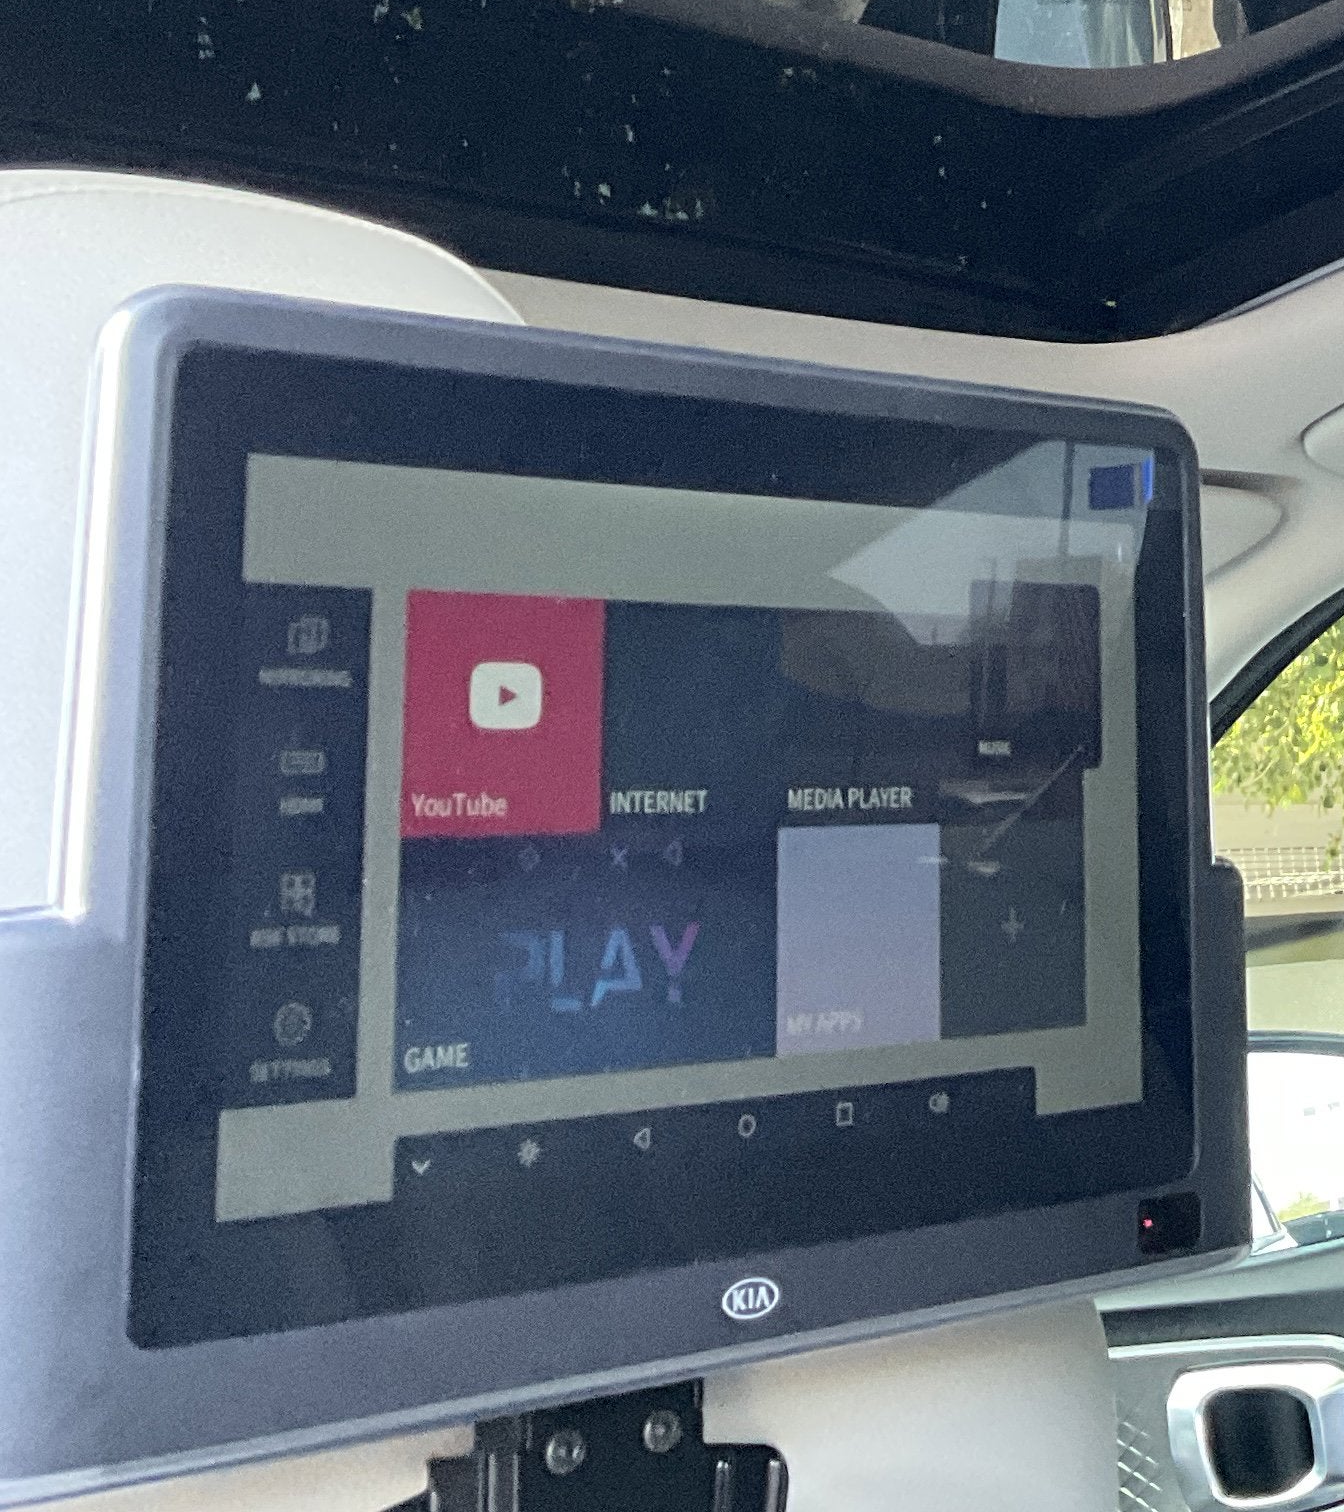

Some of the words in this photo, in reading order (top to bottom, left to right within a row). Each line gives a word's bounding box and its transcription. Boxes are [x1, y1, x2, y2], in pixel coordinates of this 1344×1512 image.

[411, 791, 508, 817] YouTube
[610, 789, 708, 814] INTERNET
[788, 788, 844, 810] MEDIA
[848, 787, 912, 810] PLAYER
[498, 922, 699, 1012] PLAY
[404, 1043, 469, 1073] GAME
